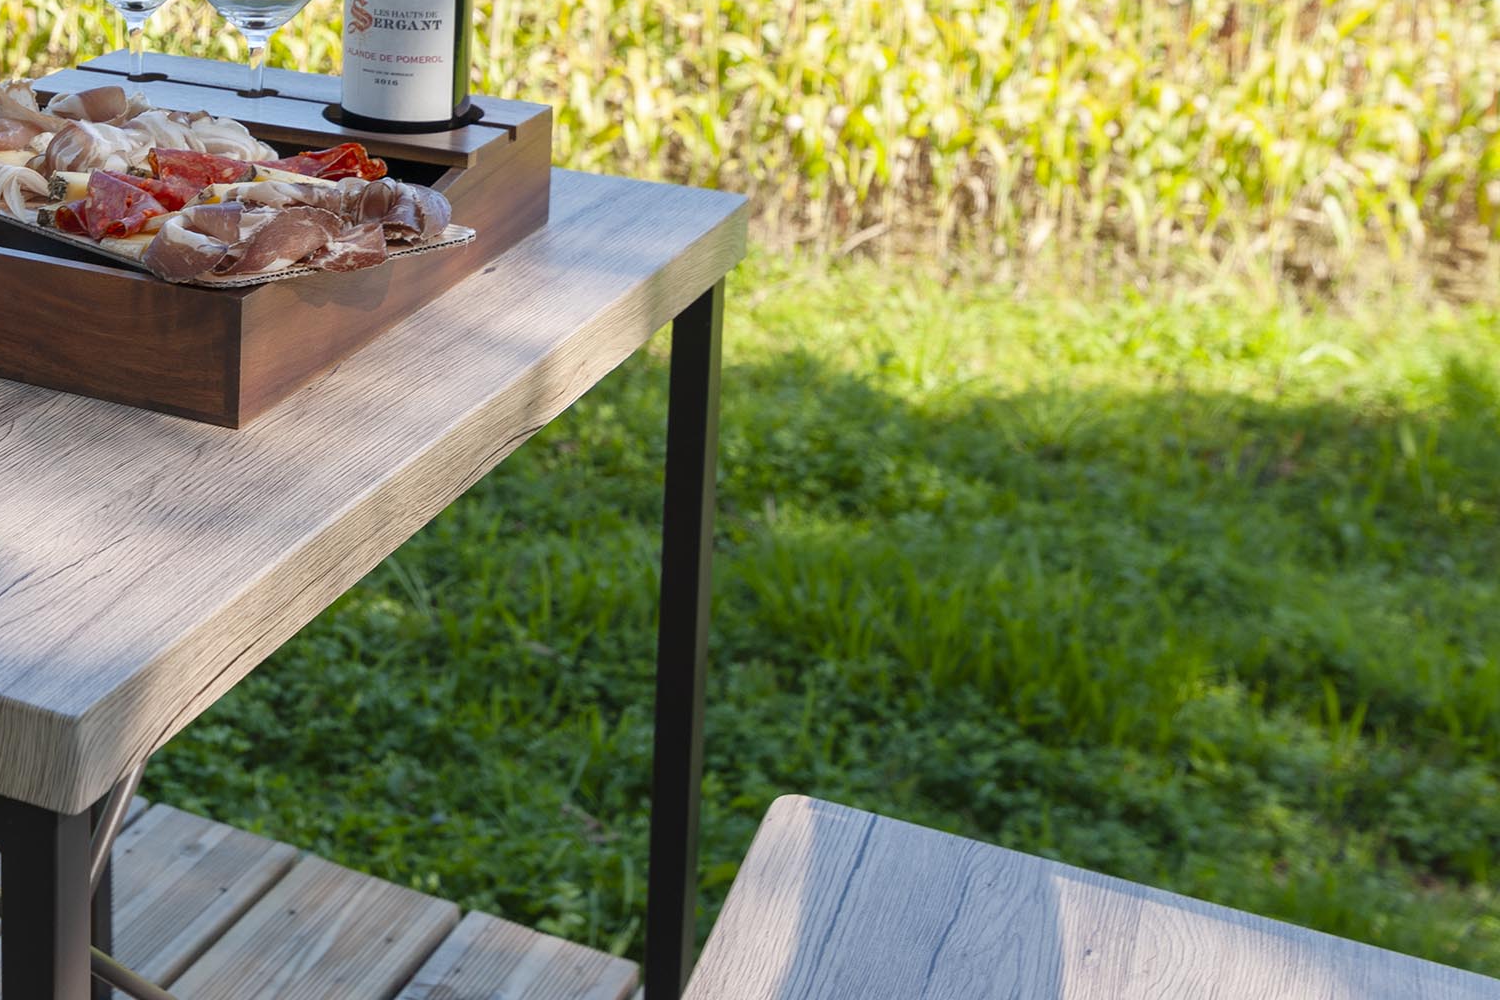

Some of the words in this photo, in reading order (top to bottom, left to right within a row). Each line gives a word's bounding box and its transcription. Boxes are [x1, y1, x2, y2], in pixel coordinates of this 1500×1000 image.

[373, 8, 390, 17] LES
[391, 10, 424, 19] HAUTS
[425, 11, 438, 19] DE
[347, 47, 377, 60] ALANDE
[380, 53, 393, 62] DE
[395, 55, 444, 64] POMEROL
